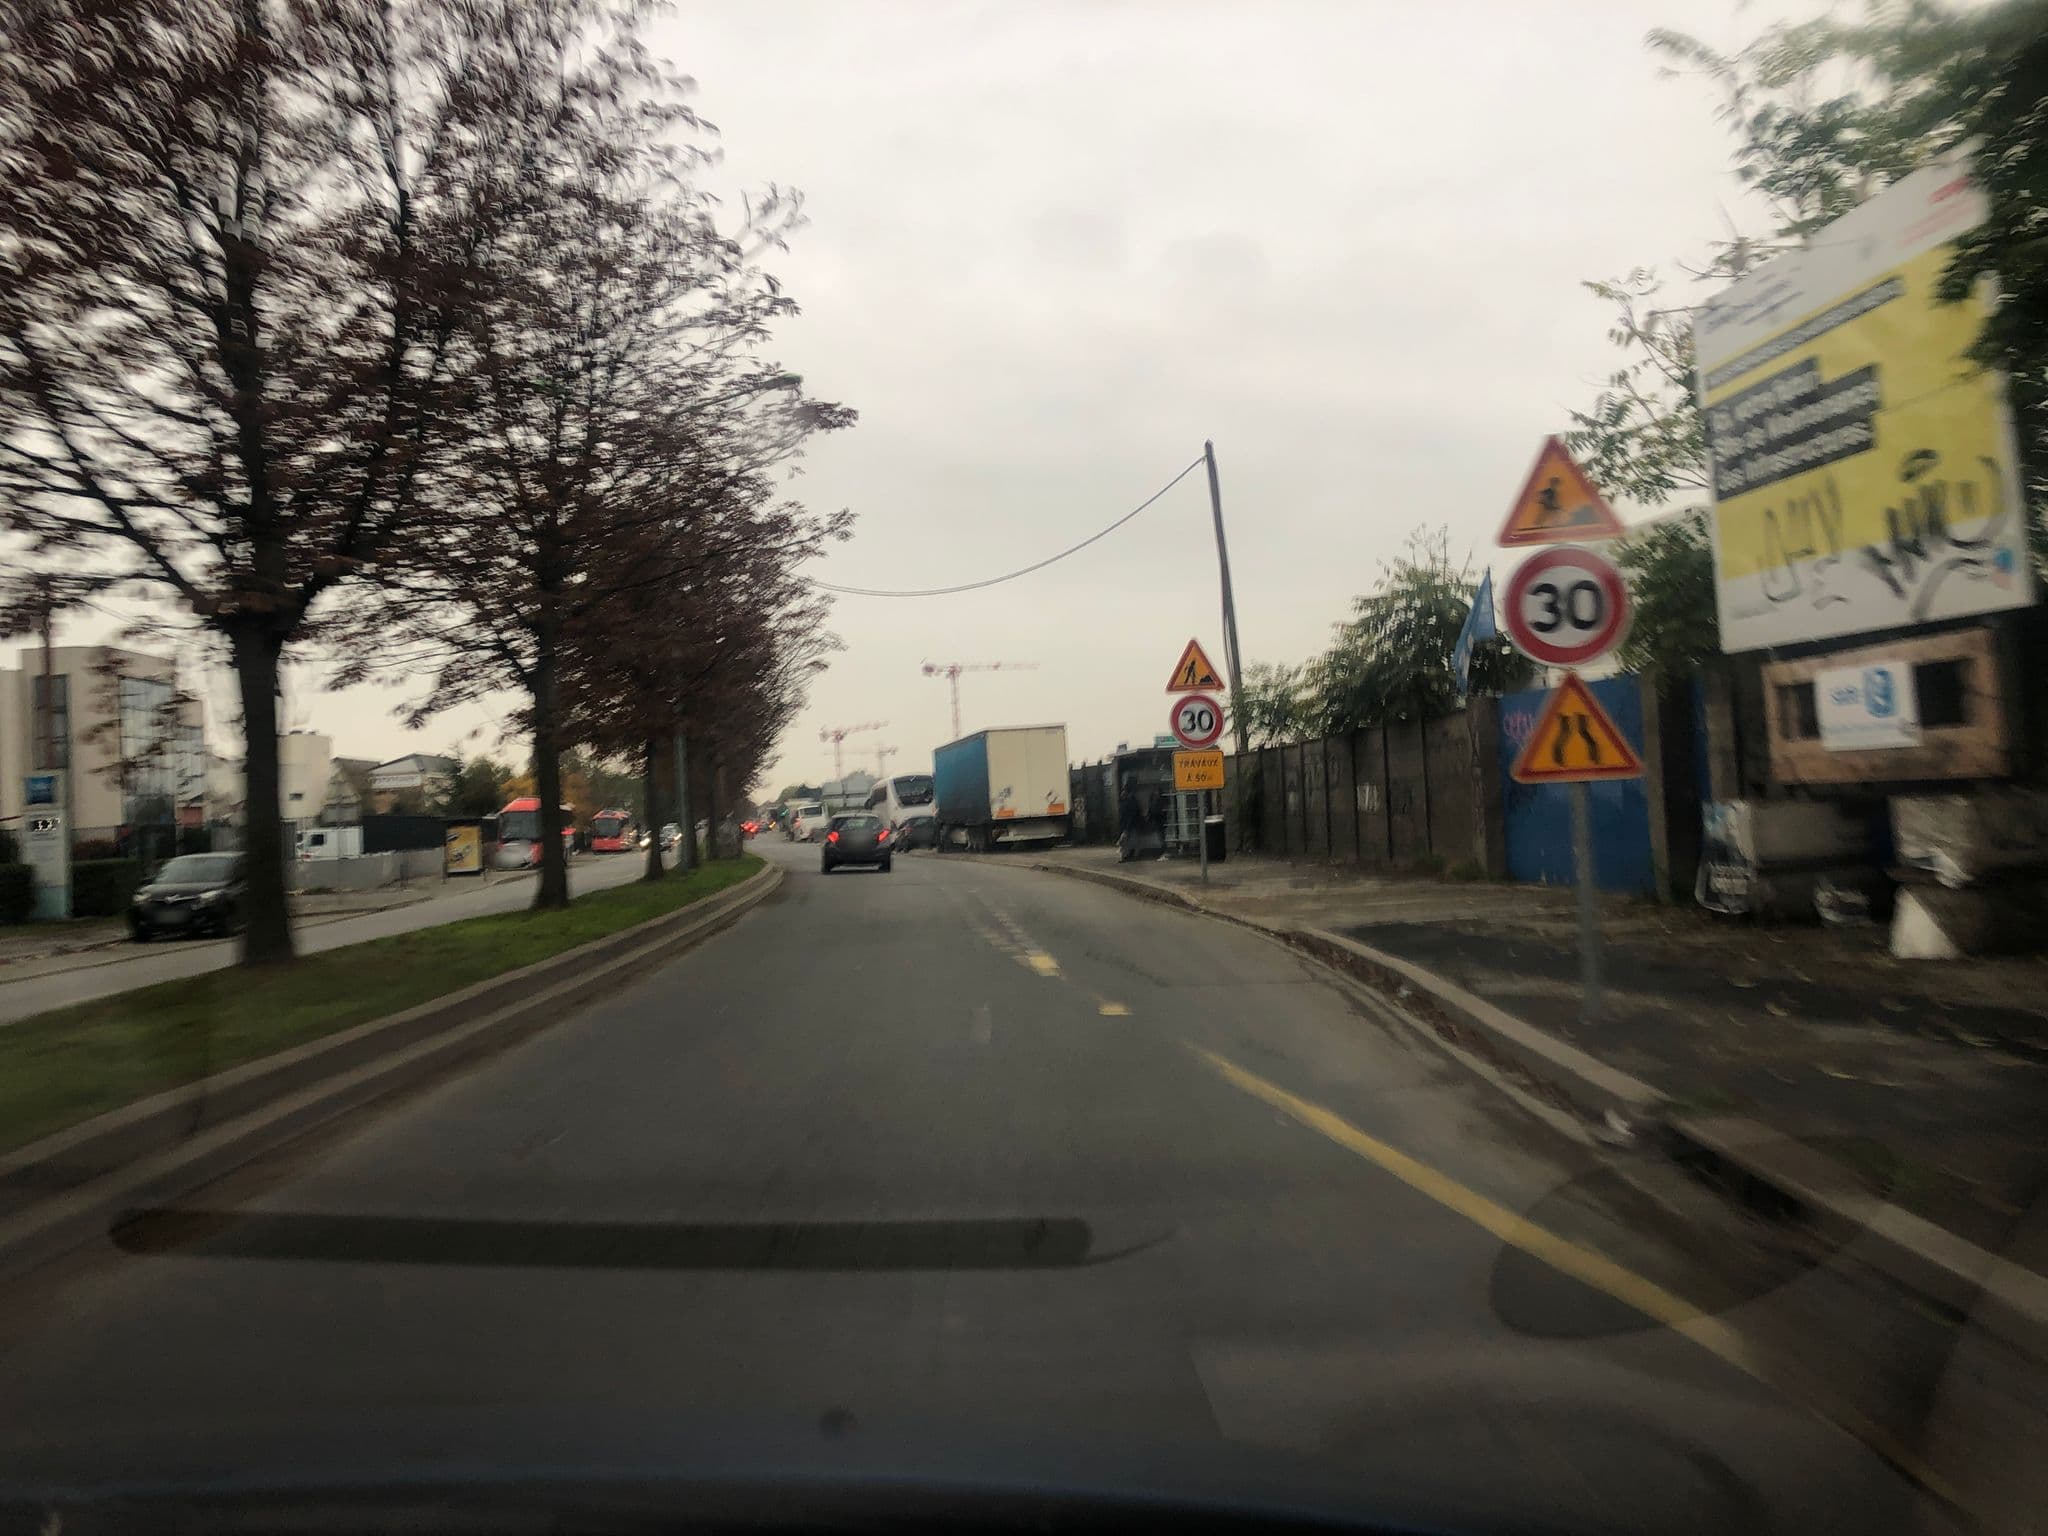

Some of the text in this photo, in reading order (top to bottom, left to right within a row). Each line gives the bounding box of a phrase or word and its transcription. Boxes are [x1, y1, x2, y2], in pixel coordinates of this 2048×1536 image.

[1527, 580, 1603, 634] 30
[1181, 710, 1213, 731] 30
[1179, 757, 1218, 768] TRAVAUX
